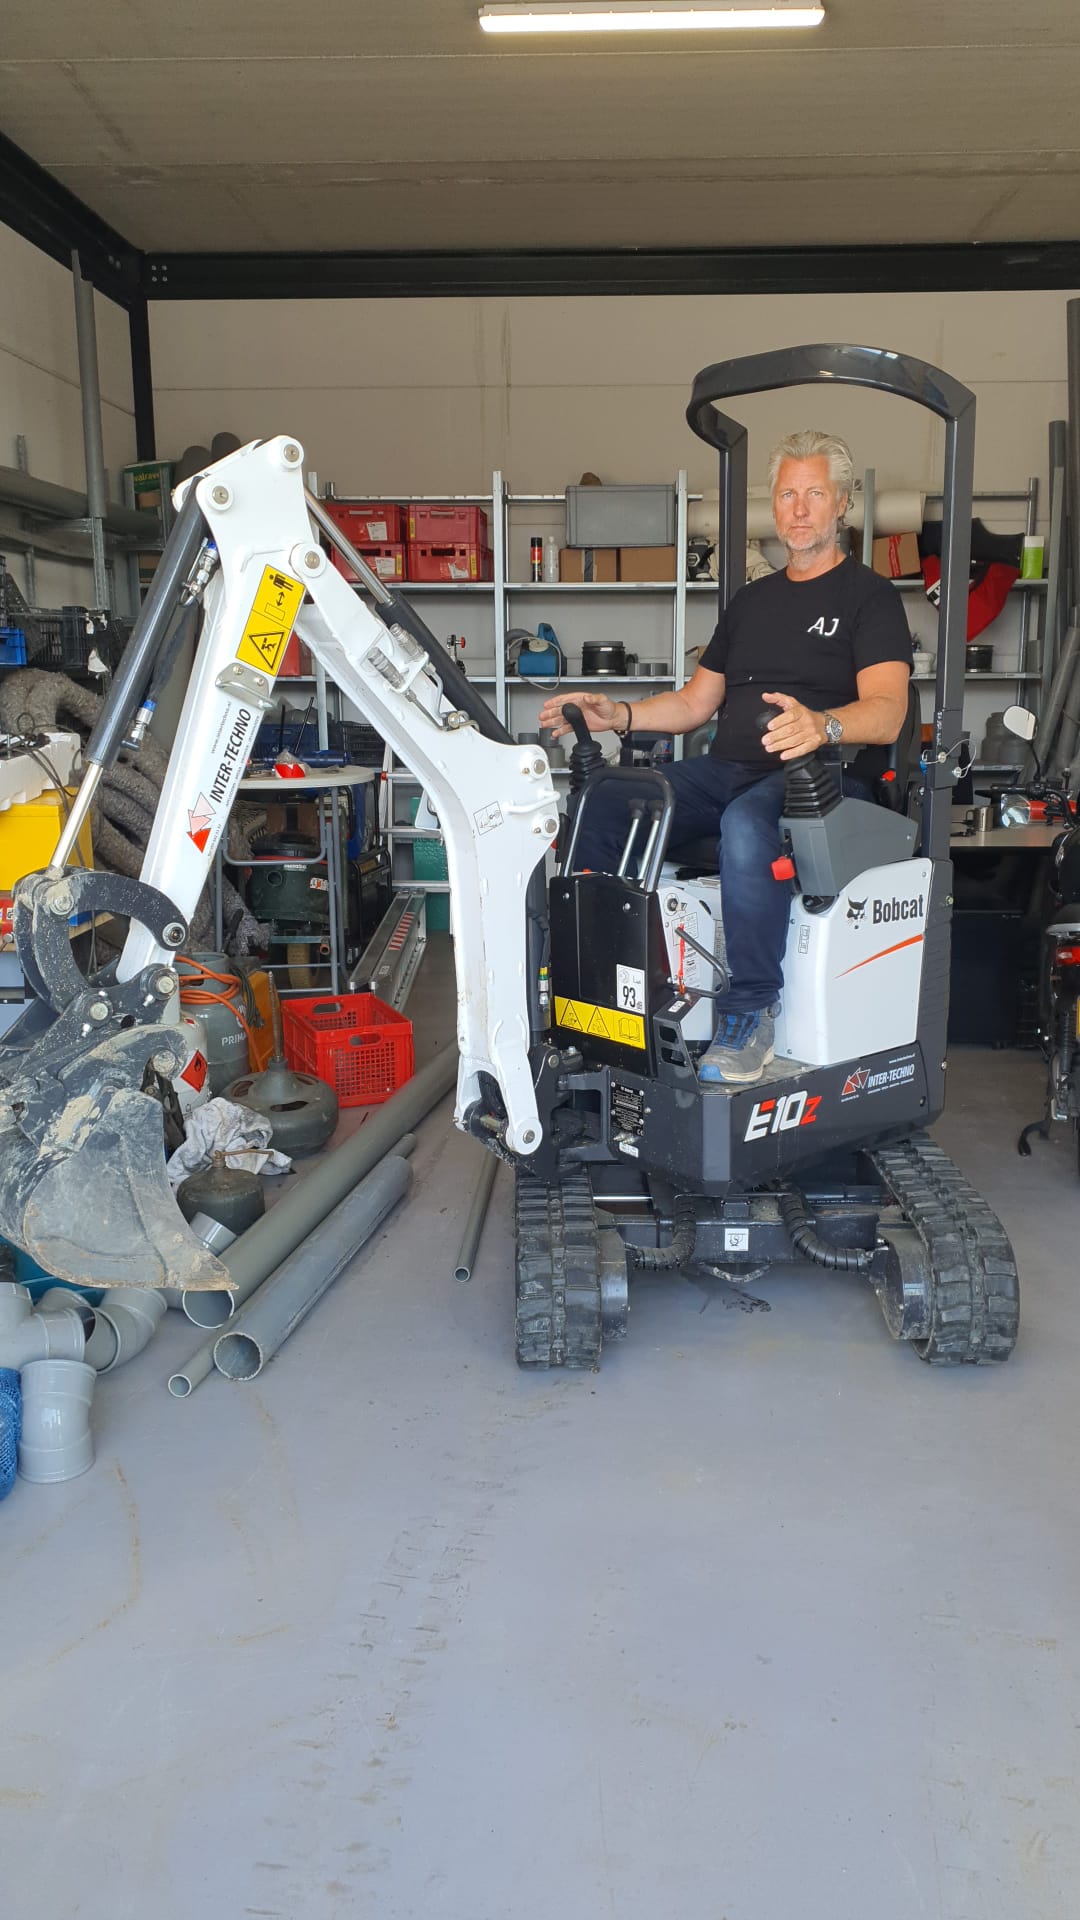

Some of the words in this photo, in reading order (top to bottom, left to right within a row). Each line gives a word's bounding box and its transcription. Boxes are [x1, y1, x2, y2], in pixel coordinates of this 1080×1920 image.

[807, 616, 840, 636] AJ
[209, 708, 252, 804] INTER-TECHNO
[872, 894, 924, 924] Bobcat
[622, 985, 636, 1008] 93
[867, 1064, 915, 1089] INTER-TECHNO
